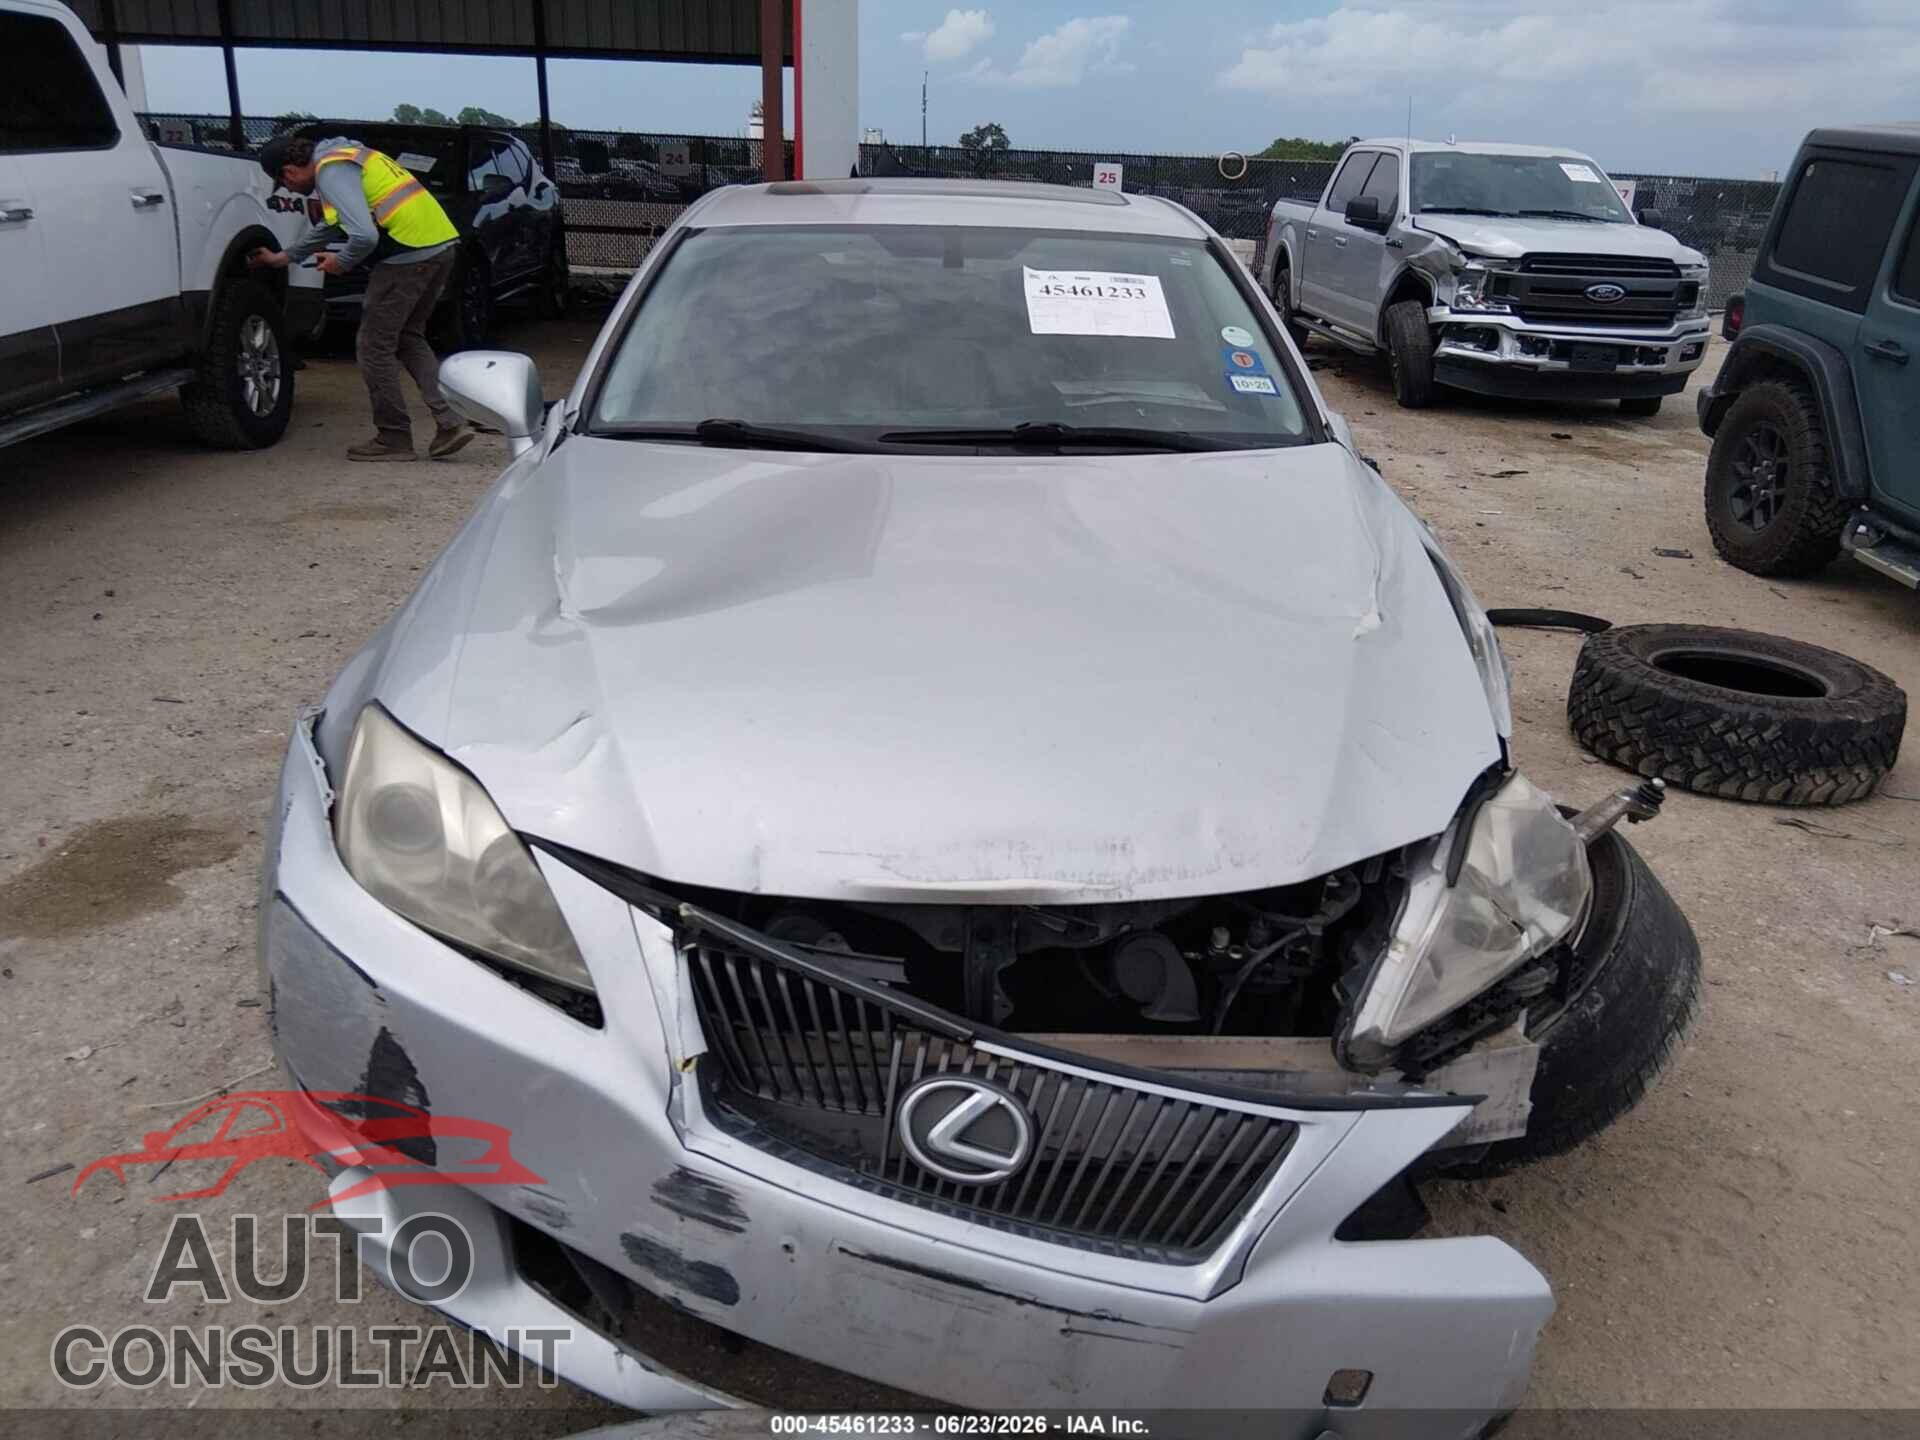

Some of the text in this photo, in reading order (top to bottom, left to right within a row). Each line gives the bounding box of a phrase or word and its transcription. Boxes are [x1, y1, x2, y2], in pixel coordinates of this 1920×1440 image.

[665, 152, 684, 165] 24
[1099, 172, 1117, 184] 25
[1039, 284, 1147, 299] 45461233
